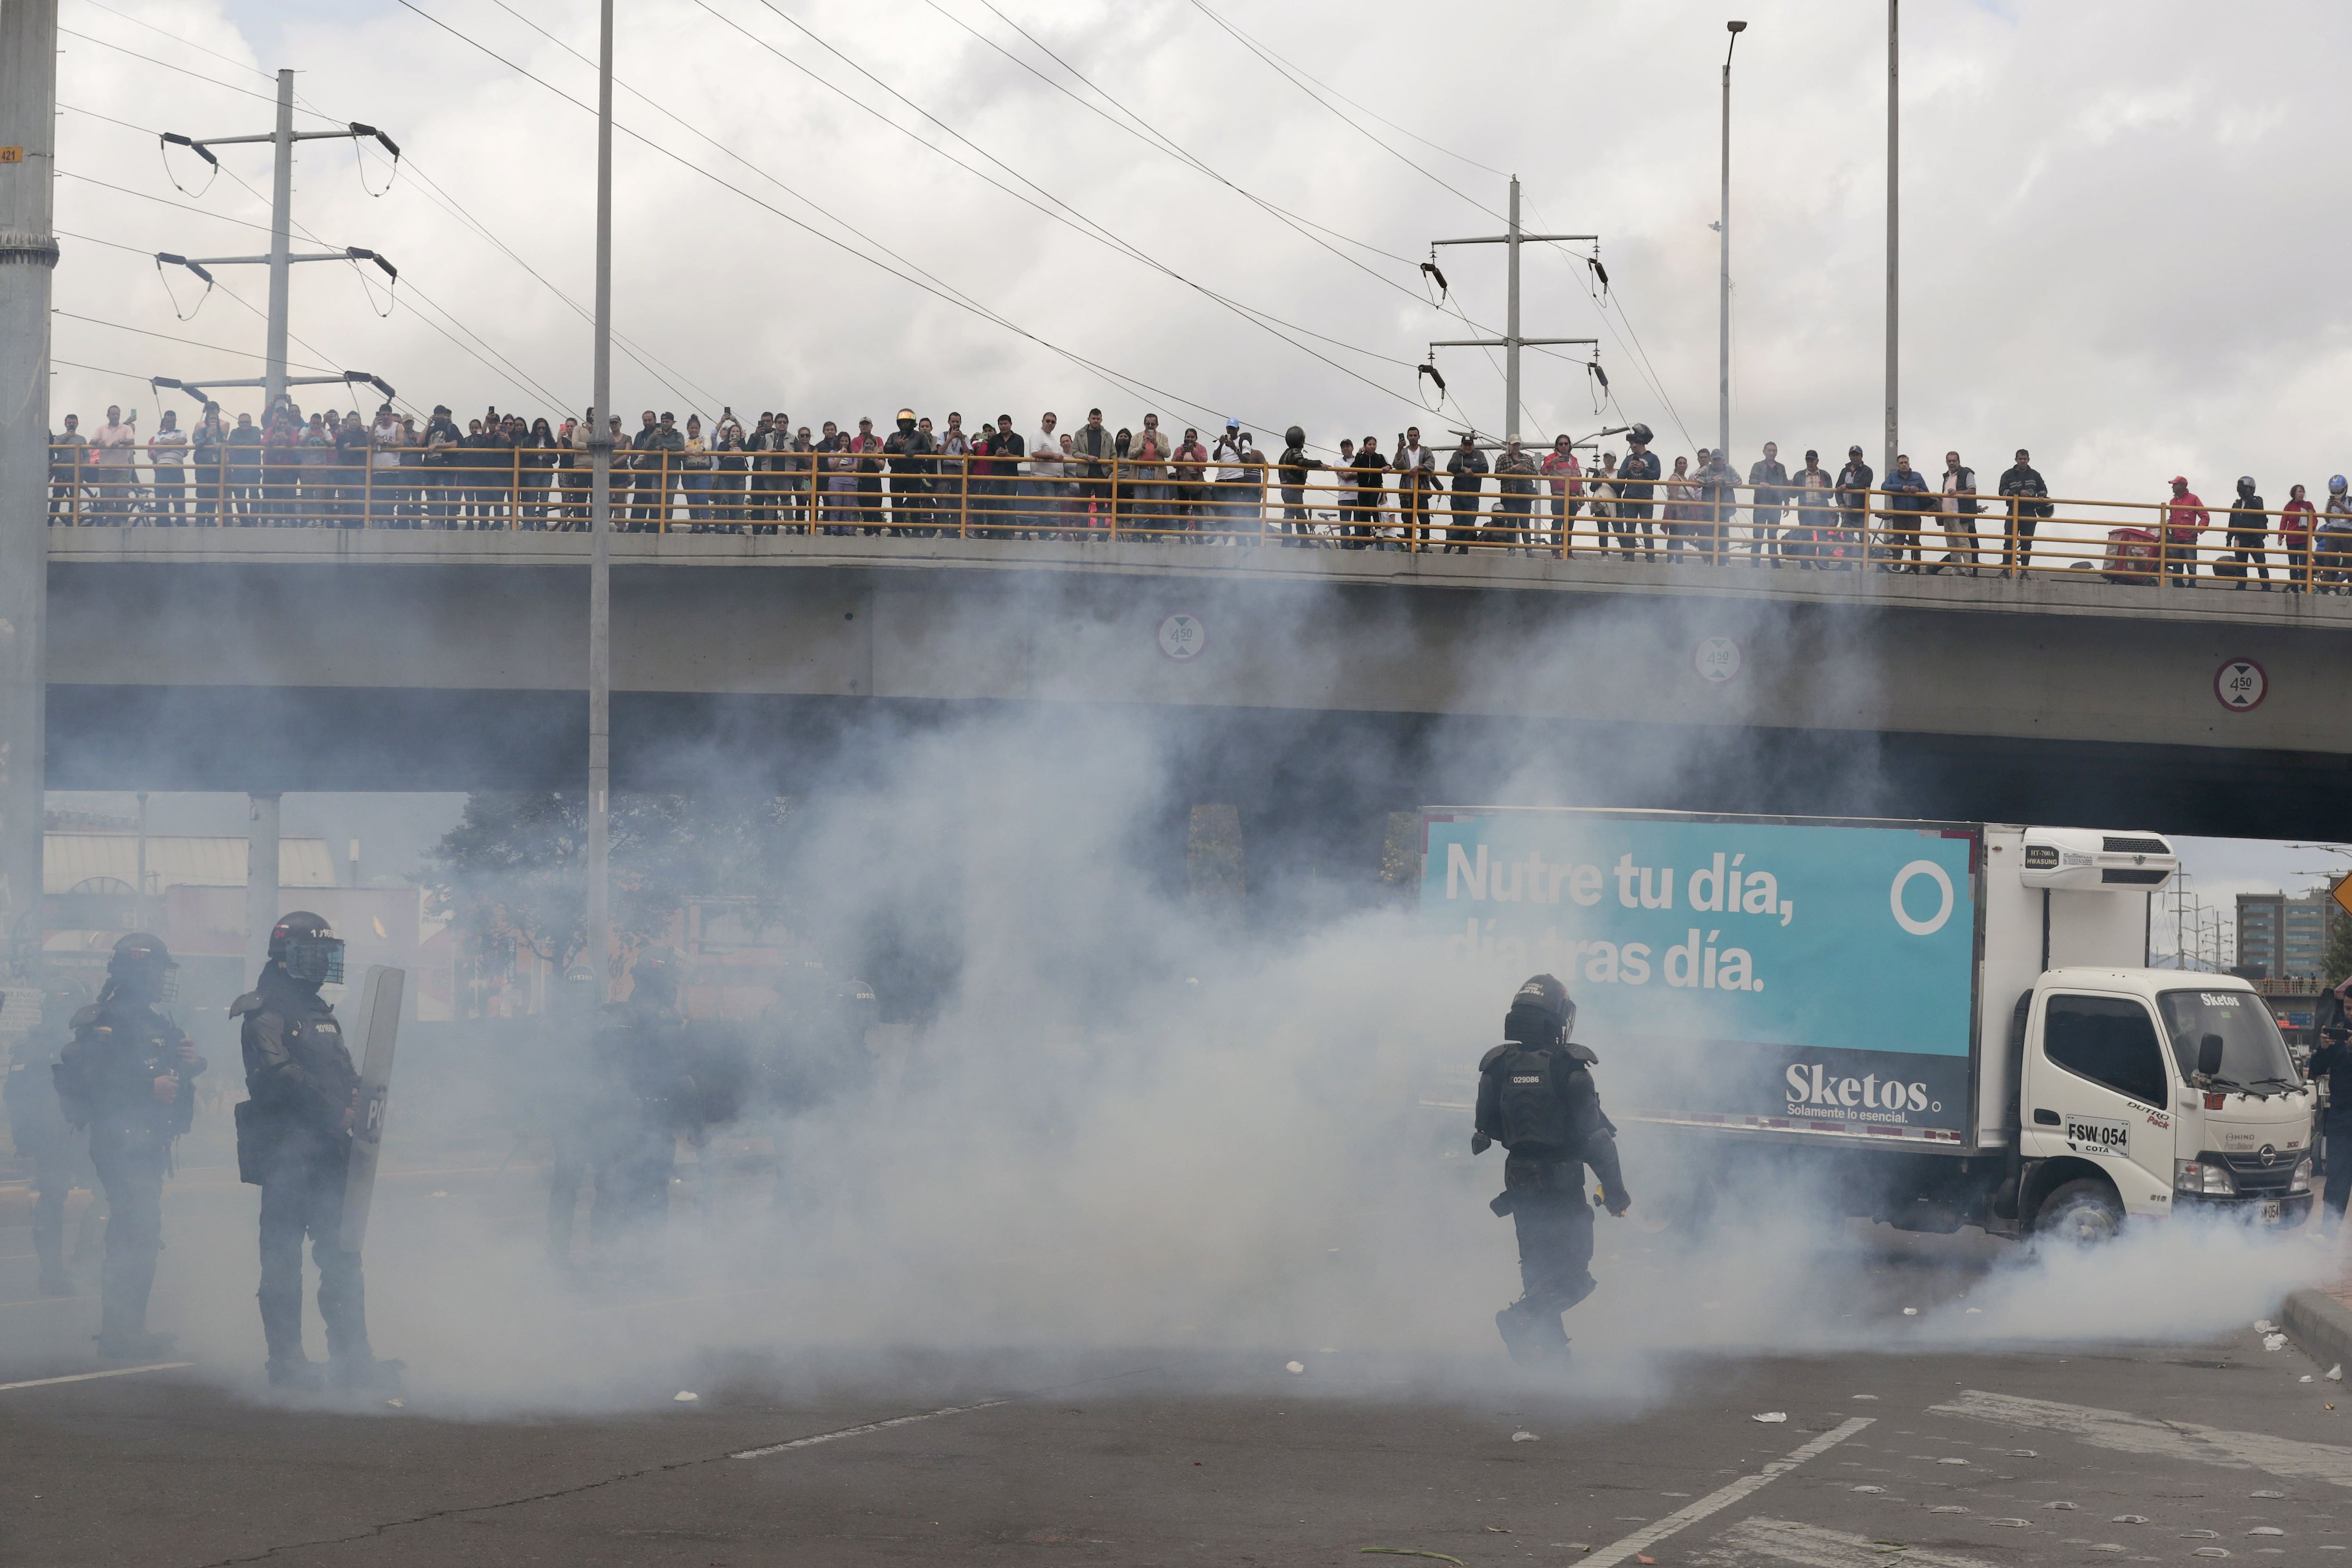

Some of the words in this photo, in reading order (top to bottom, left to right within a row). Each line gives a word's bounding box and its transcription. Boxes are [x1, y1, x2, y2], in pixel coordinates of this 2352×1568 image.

[1, 150, 15, 160] 421
[1446, 843, 1603, 906] Nutre
[1614, 852, 1674, 909] tu
[1688, 852, 1794, 927] día,
[1445, 917, 1528, 978] día
[1539, 925, 1652, 985] tras
[1663, 928, 1764, 992] día.
[2201, 993, 2240, 1006] Sketos
[1786, 1063, 1928, 1112] Sketos
[1788, 1104, 1845, 1119] Solamente
[1847, 1108, 1858, 1119] lo
[1859, 1111, 1908, 1123] esencial.
[2127, 1102, 2169, 1120] DUTRO
[2147, 1115, 2169, 1130] Pack
